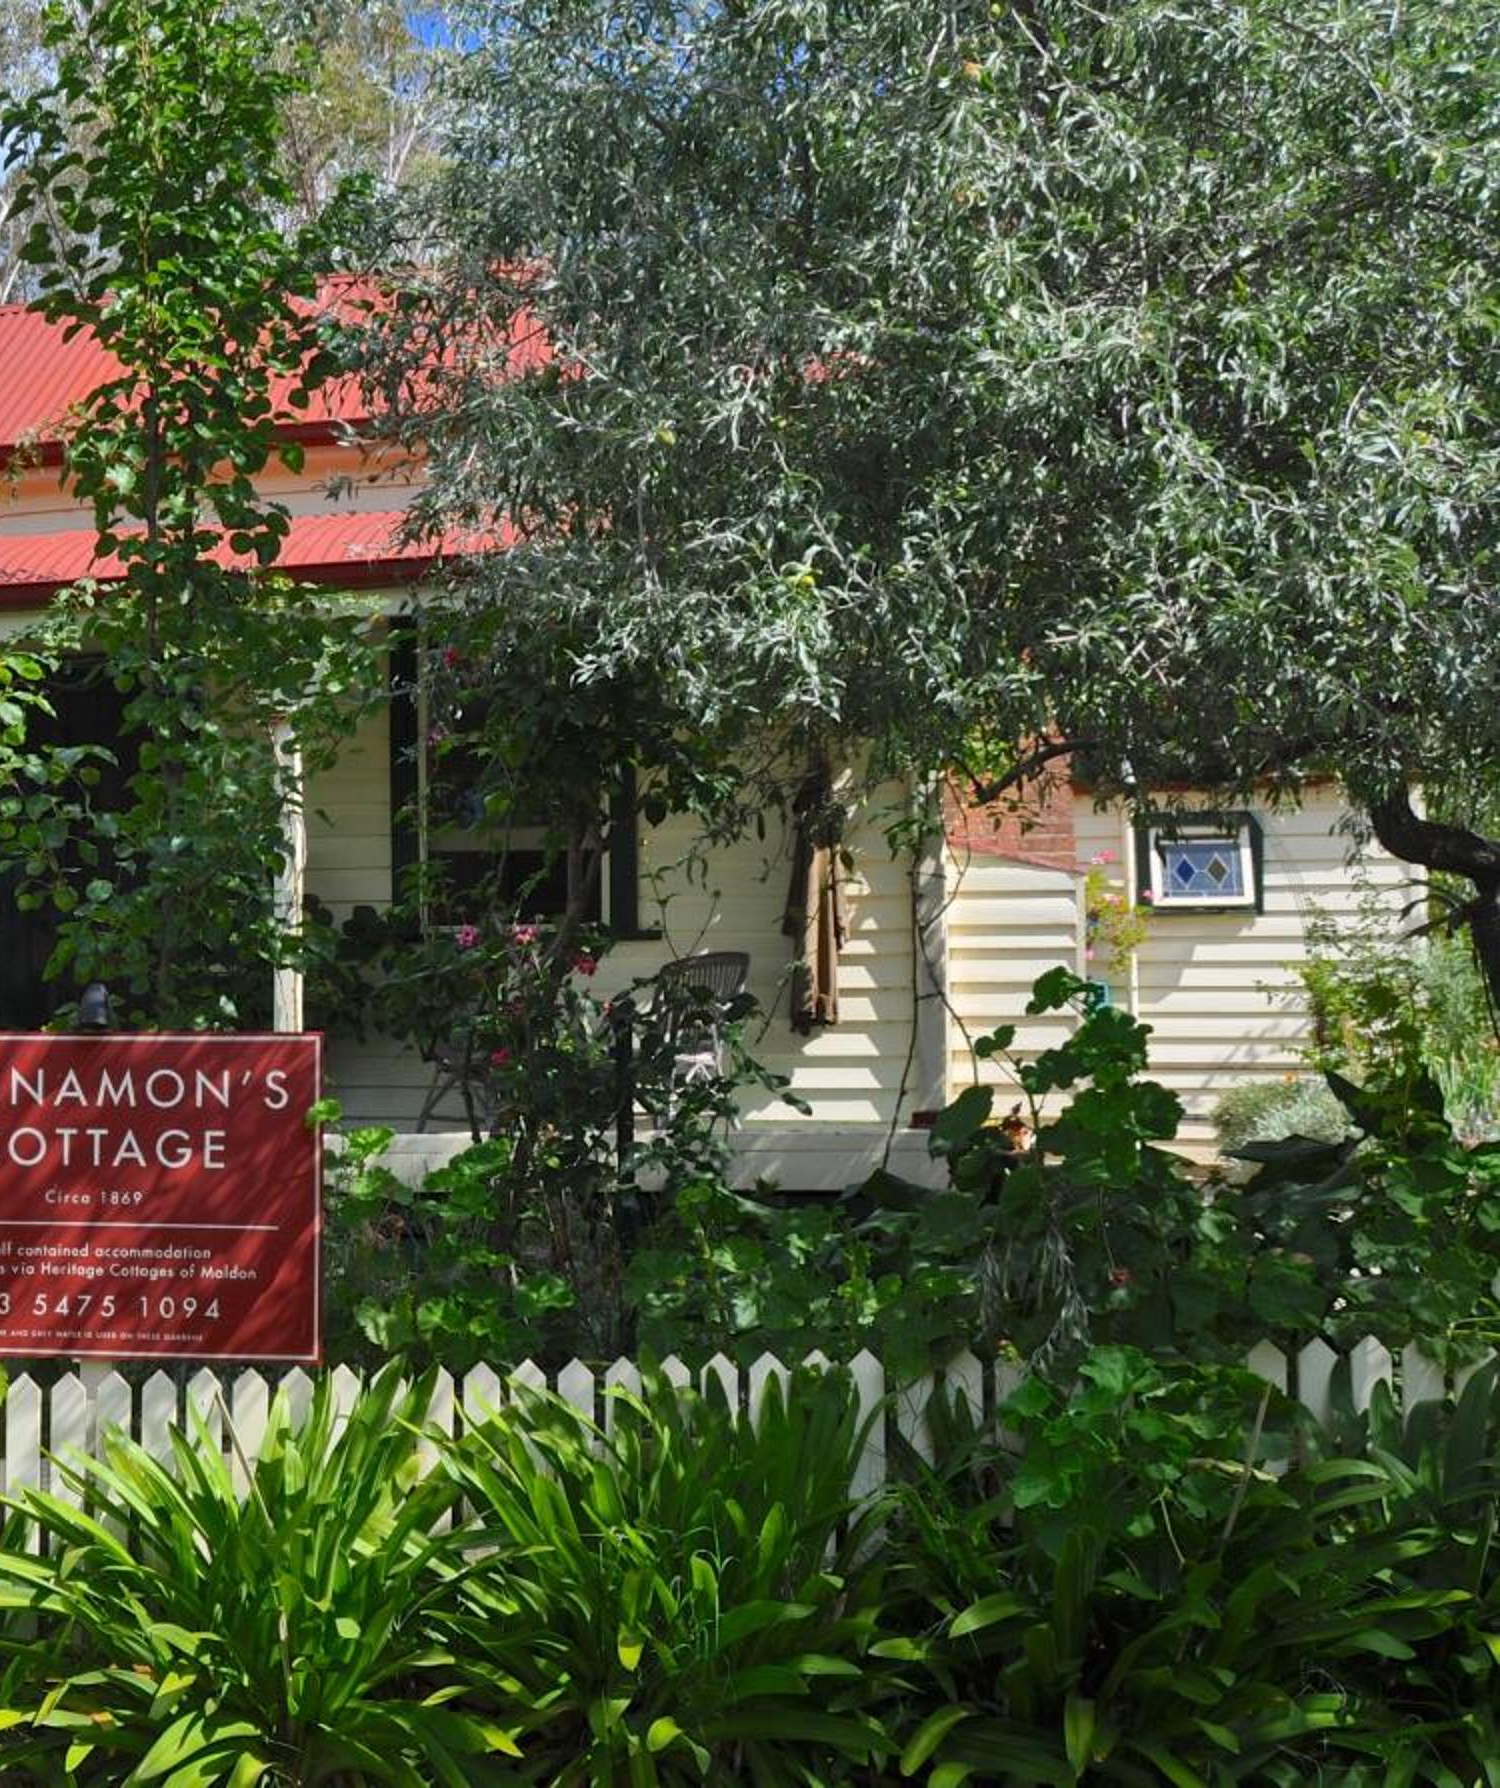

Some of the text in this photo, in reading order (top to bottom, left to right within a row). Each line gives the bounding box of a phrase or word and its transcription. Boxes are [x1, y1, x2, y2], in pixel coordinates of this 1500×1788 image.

[45, 1189, 143, 1205] Circa 1869
[17, 1244, 89, 1258] contained
[95, 1245, 211, 1260] accommodation
[11, 1261, 34, 1275] via
[41, 1261, 104, 1280] Heritage
[110, 1263, 174, 1281] Cottages
[180, 1265, 195, 1279] of
[200, 1266, 257, 1280] Maldon
[33, 1293, 115, 1318] 5475
[138, 1296, 220, 1319] 1094
